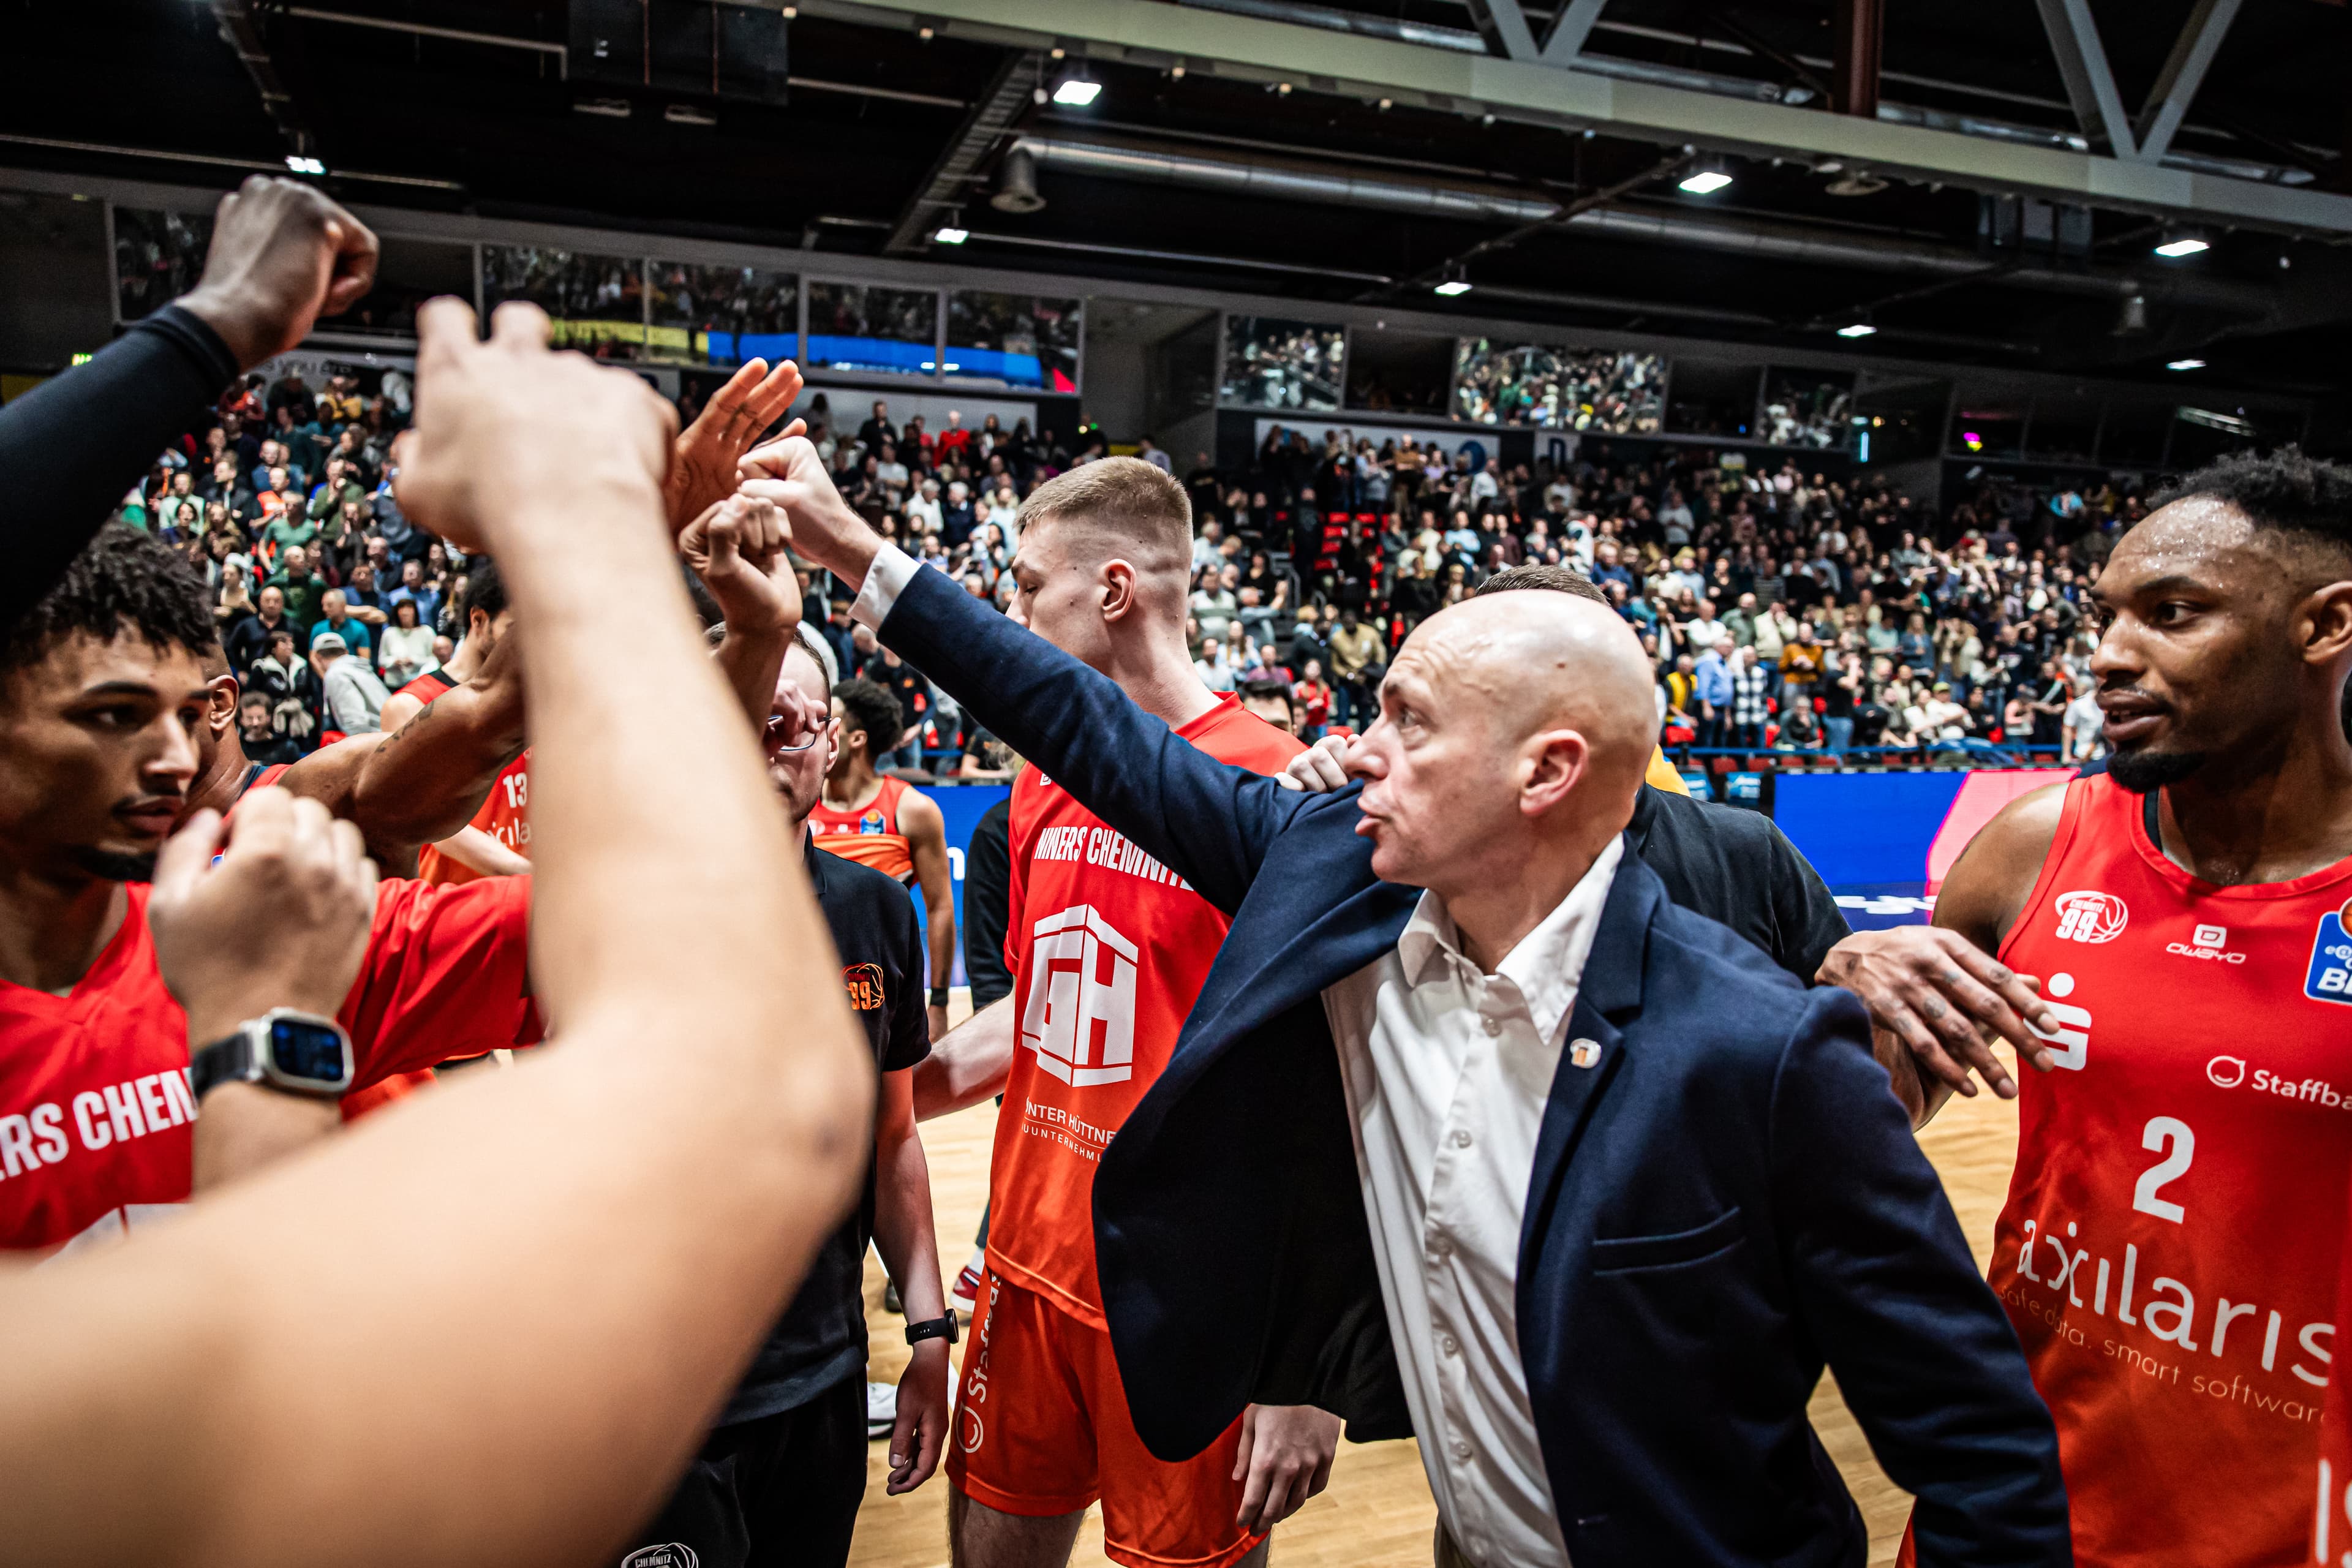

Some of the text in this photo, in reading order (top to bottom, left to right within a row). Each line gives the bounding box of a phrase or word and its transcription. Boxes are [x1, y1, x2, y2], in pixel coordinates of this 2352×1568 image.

[502, 772, 527, 809] 13
[2056, 908, 2098, 943] 99
[848, 981, 872, 1010] 99
[1025, 1096, 1066, 1125] NTER
[0, 1102, 70, 1182] RS
[2132, 1115, 2195, 1224] 2
[2016, 1219, 2336, 1387] axilaris
[2103, 1339, 2181, 1386] smart
[2191, 1374, 2328, 1424] softwar
